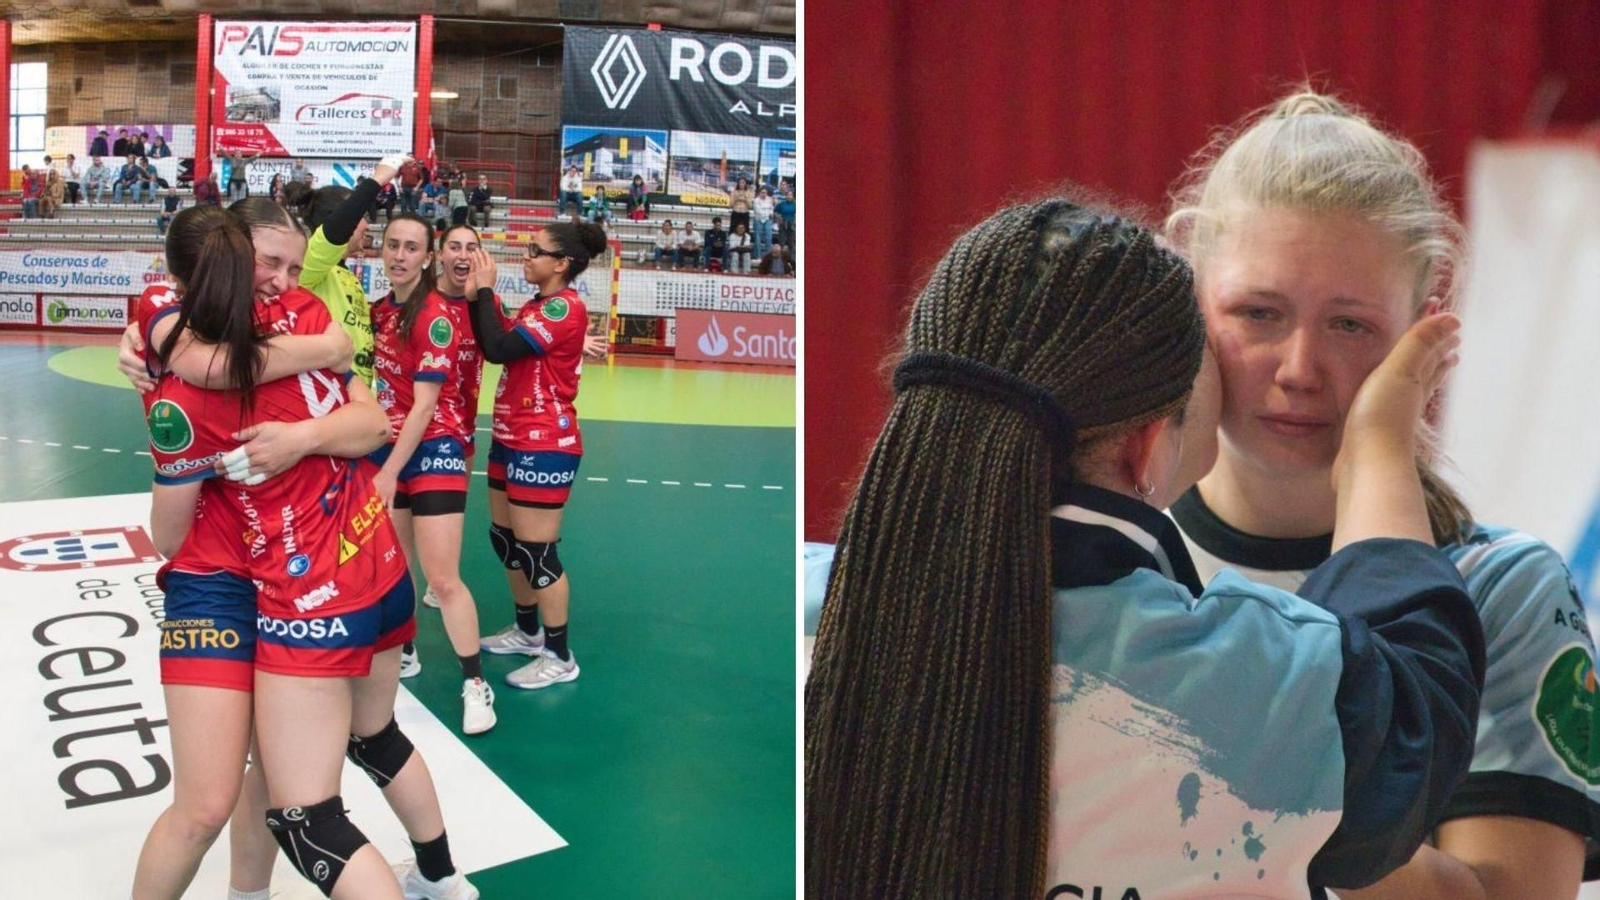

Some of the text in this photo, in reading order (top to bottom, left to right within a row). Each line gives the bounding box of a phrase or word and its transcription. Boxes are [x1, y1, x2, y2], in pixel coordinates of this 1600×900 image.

[218, 26, 409, 56] PAIS AUTOMOCION
[309, 107, 402, 120] Talleres CPR
[249, 175, 265, 185] DE
[22, 254, 108, 268] Conservas de
[0, 271, 131, 287] Pescados y Mariscos
[721, 284, 794, 302] DEPUTAC
[76, 578, 120, 601] de
[160, 628, 240, 650] ASTRO
[32, 611, 171, 809] Ceuta
